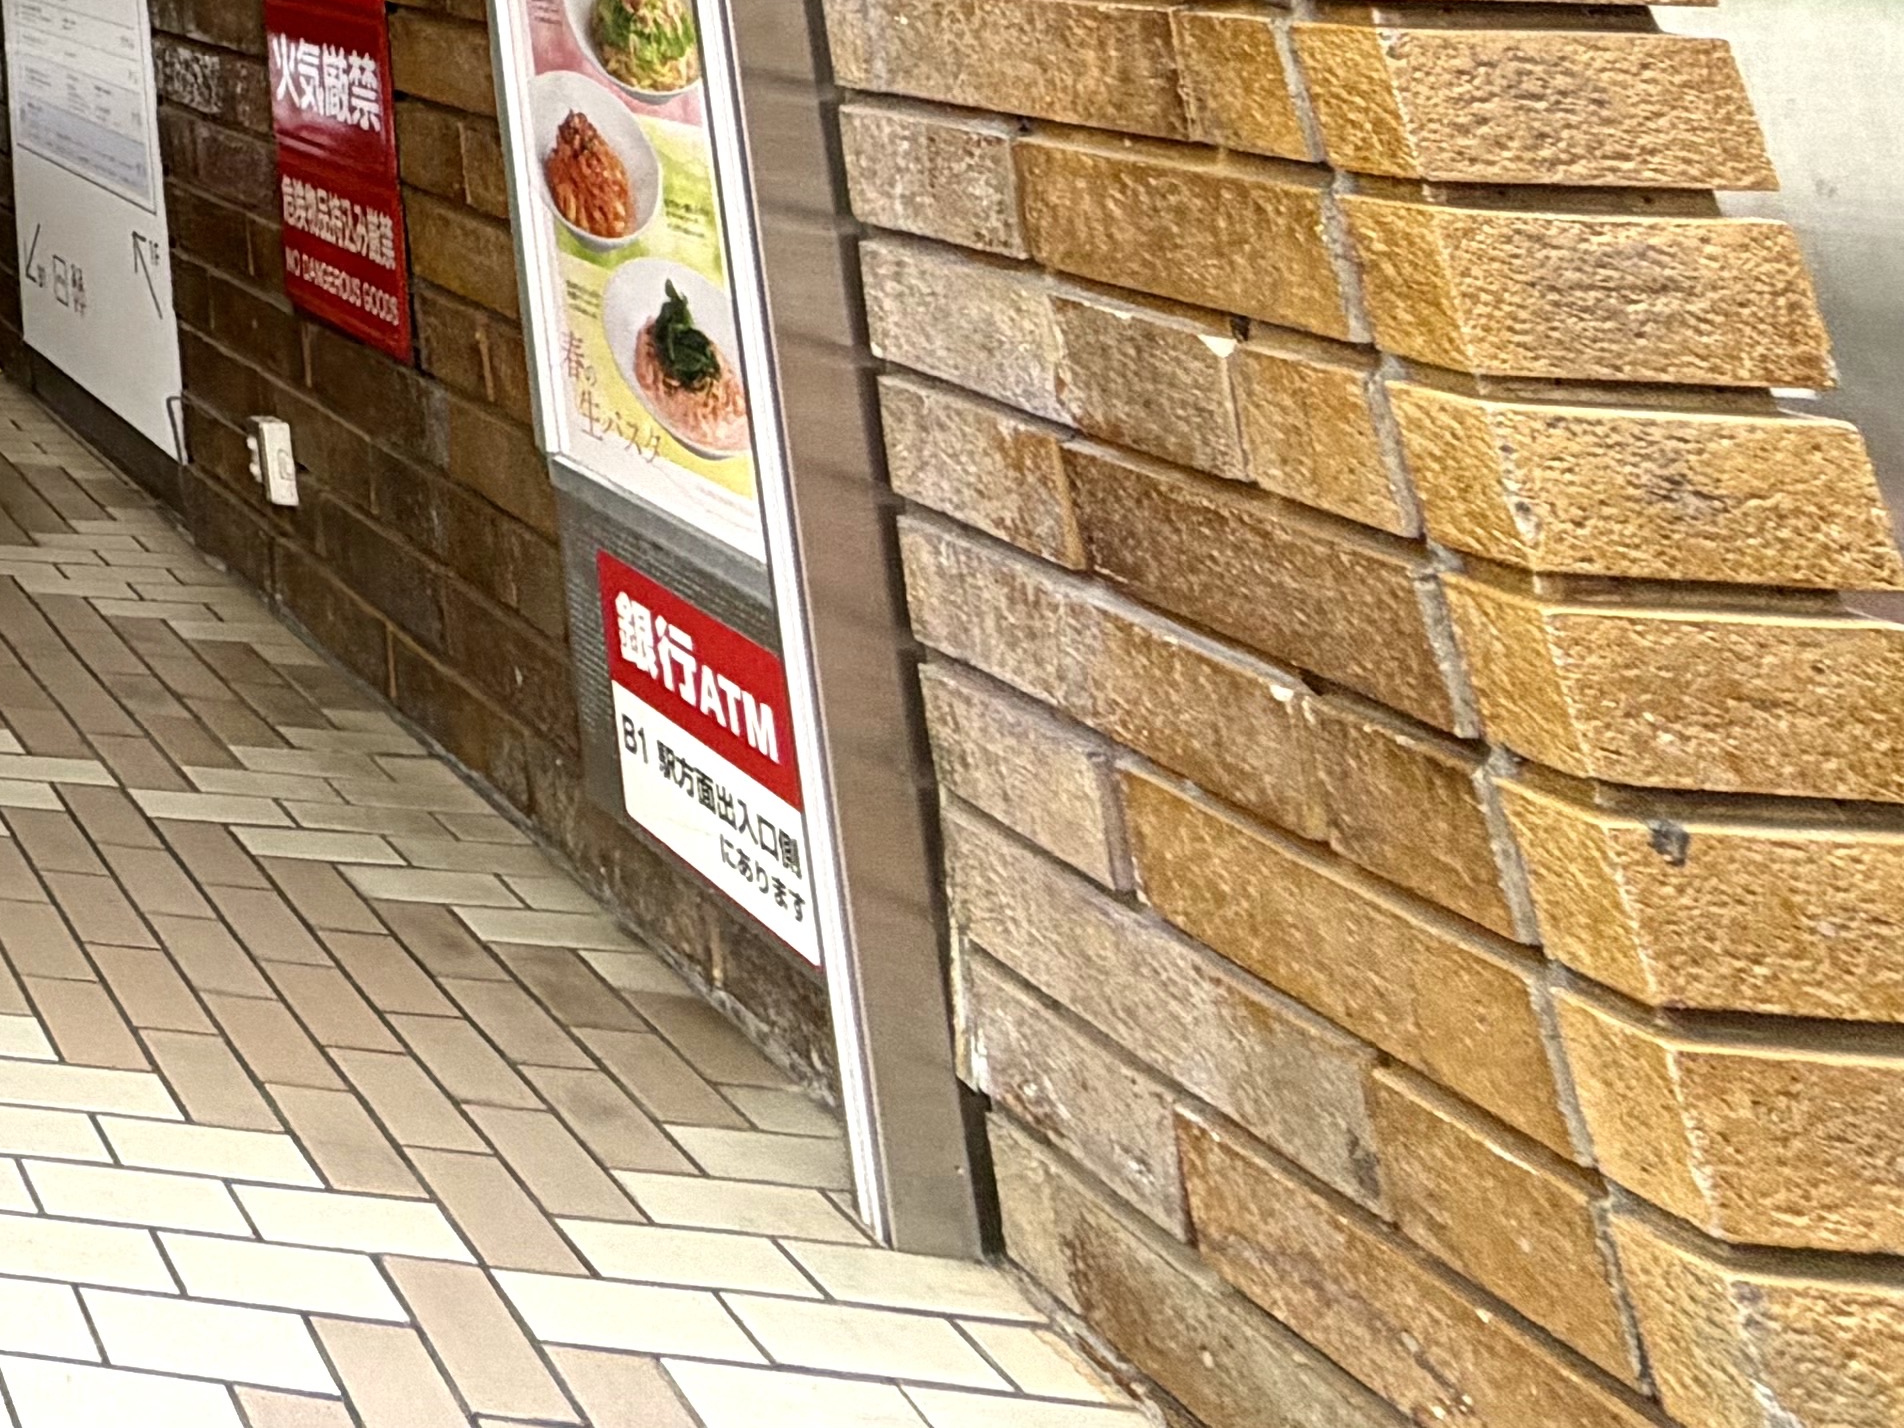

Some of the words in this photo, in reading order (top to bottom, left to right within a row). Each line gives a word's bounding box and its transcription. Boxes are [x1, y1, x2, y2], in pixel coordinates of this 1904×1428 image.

[271, 32, 382, 132] 火気厳禁
[285, 246, 301, 278] NO
[301, 252, 362, 311] DANGEROUS
[362, 282, 400, 328] GOODS
[578, 388, 662, 463] 生パスタ
[614, 590, 781, 766] 銀行ATM
[621, 710, 649, 765] B1
[656, 738, 803, 880] 駅方面出入口側
[718, 832, 806, 924] にあります
